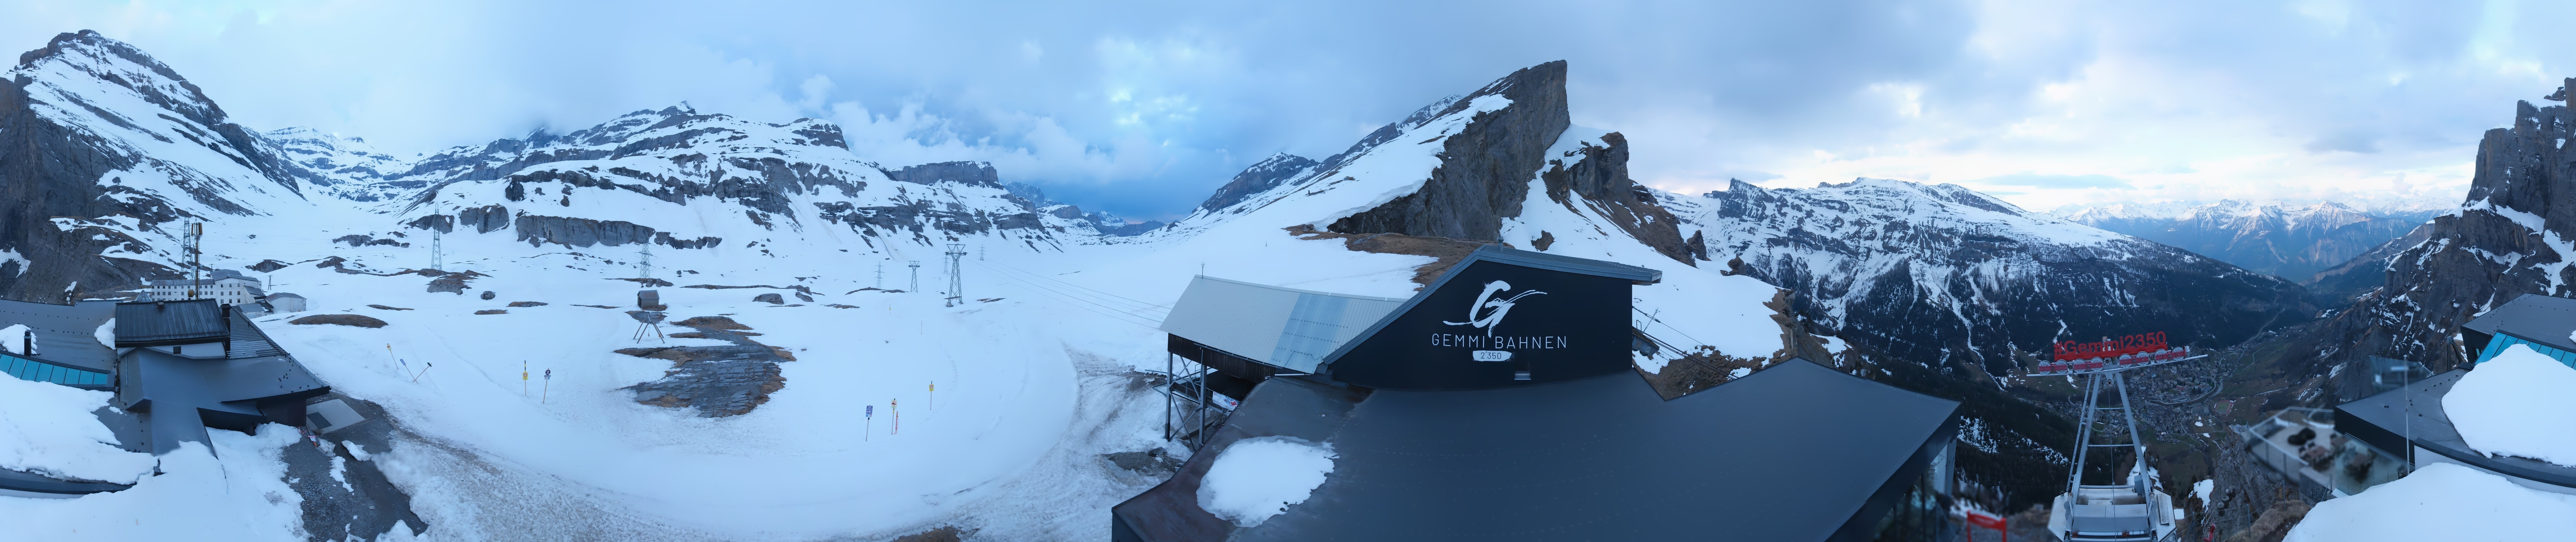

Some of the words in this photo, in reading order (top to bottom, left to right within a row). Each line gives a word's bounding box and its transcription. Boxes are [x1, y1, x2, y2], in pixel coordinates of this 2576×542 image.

[1432, 333, 1485, 348] GEMMI
[1495, 336, 1566, 349] BAHNEN
[2054, 331, 2166, 355] #Gemmi2350
[1481, 351, 1502, 359] 2'350
